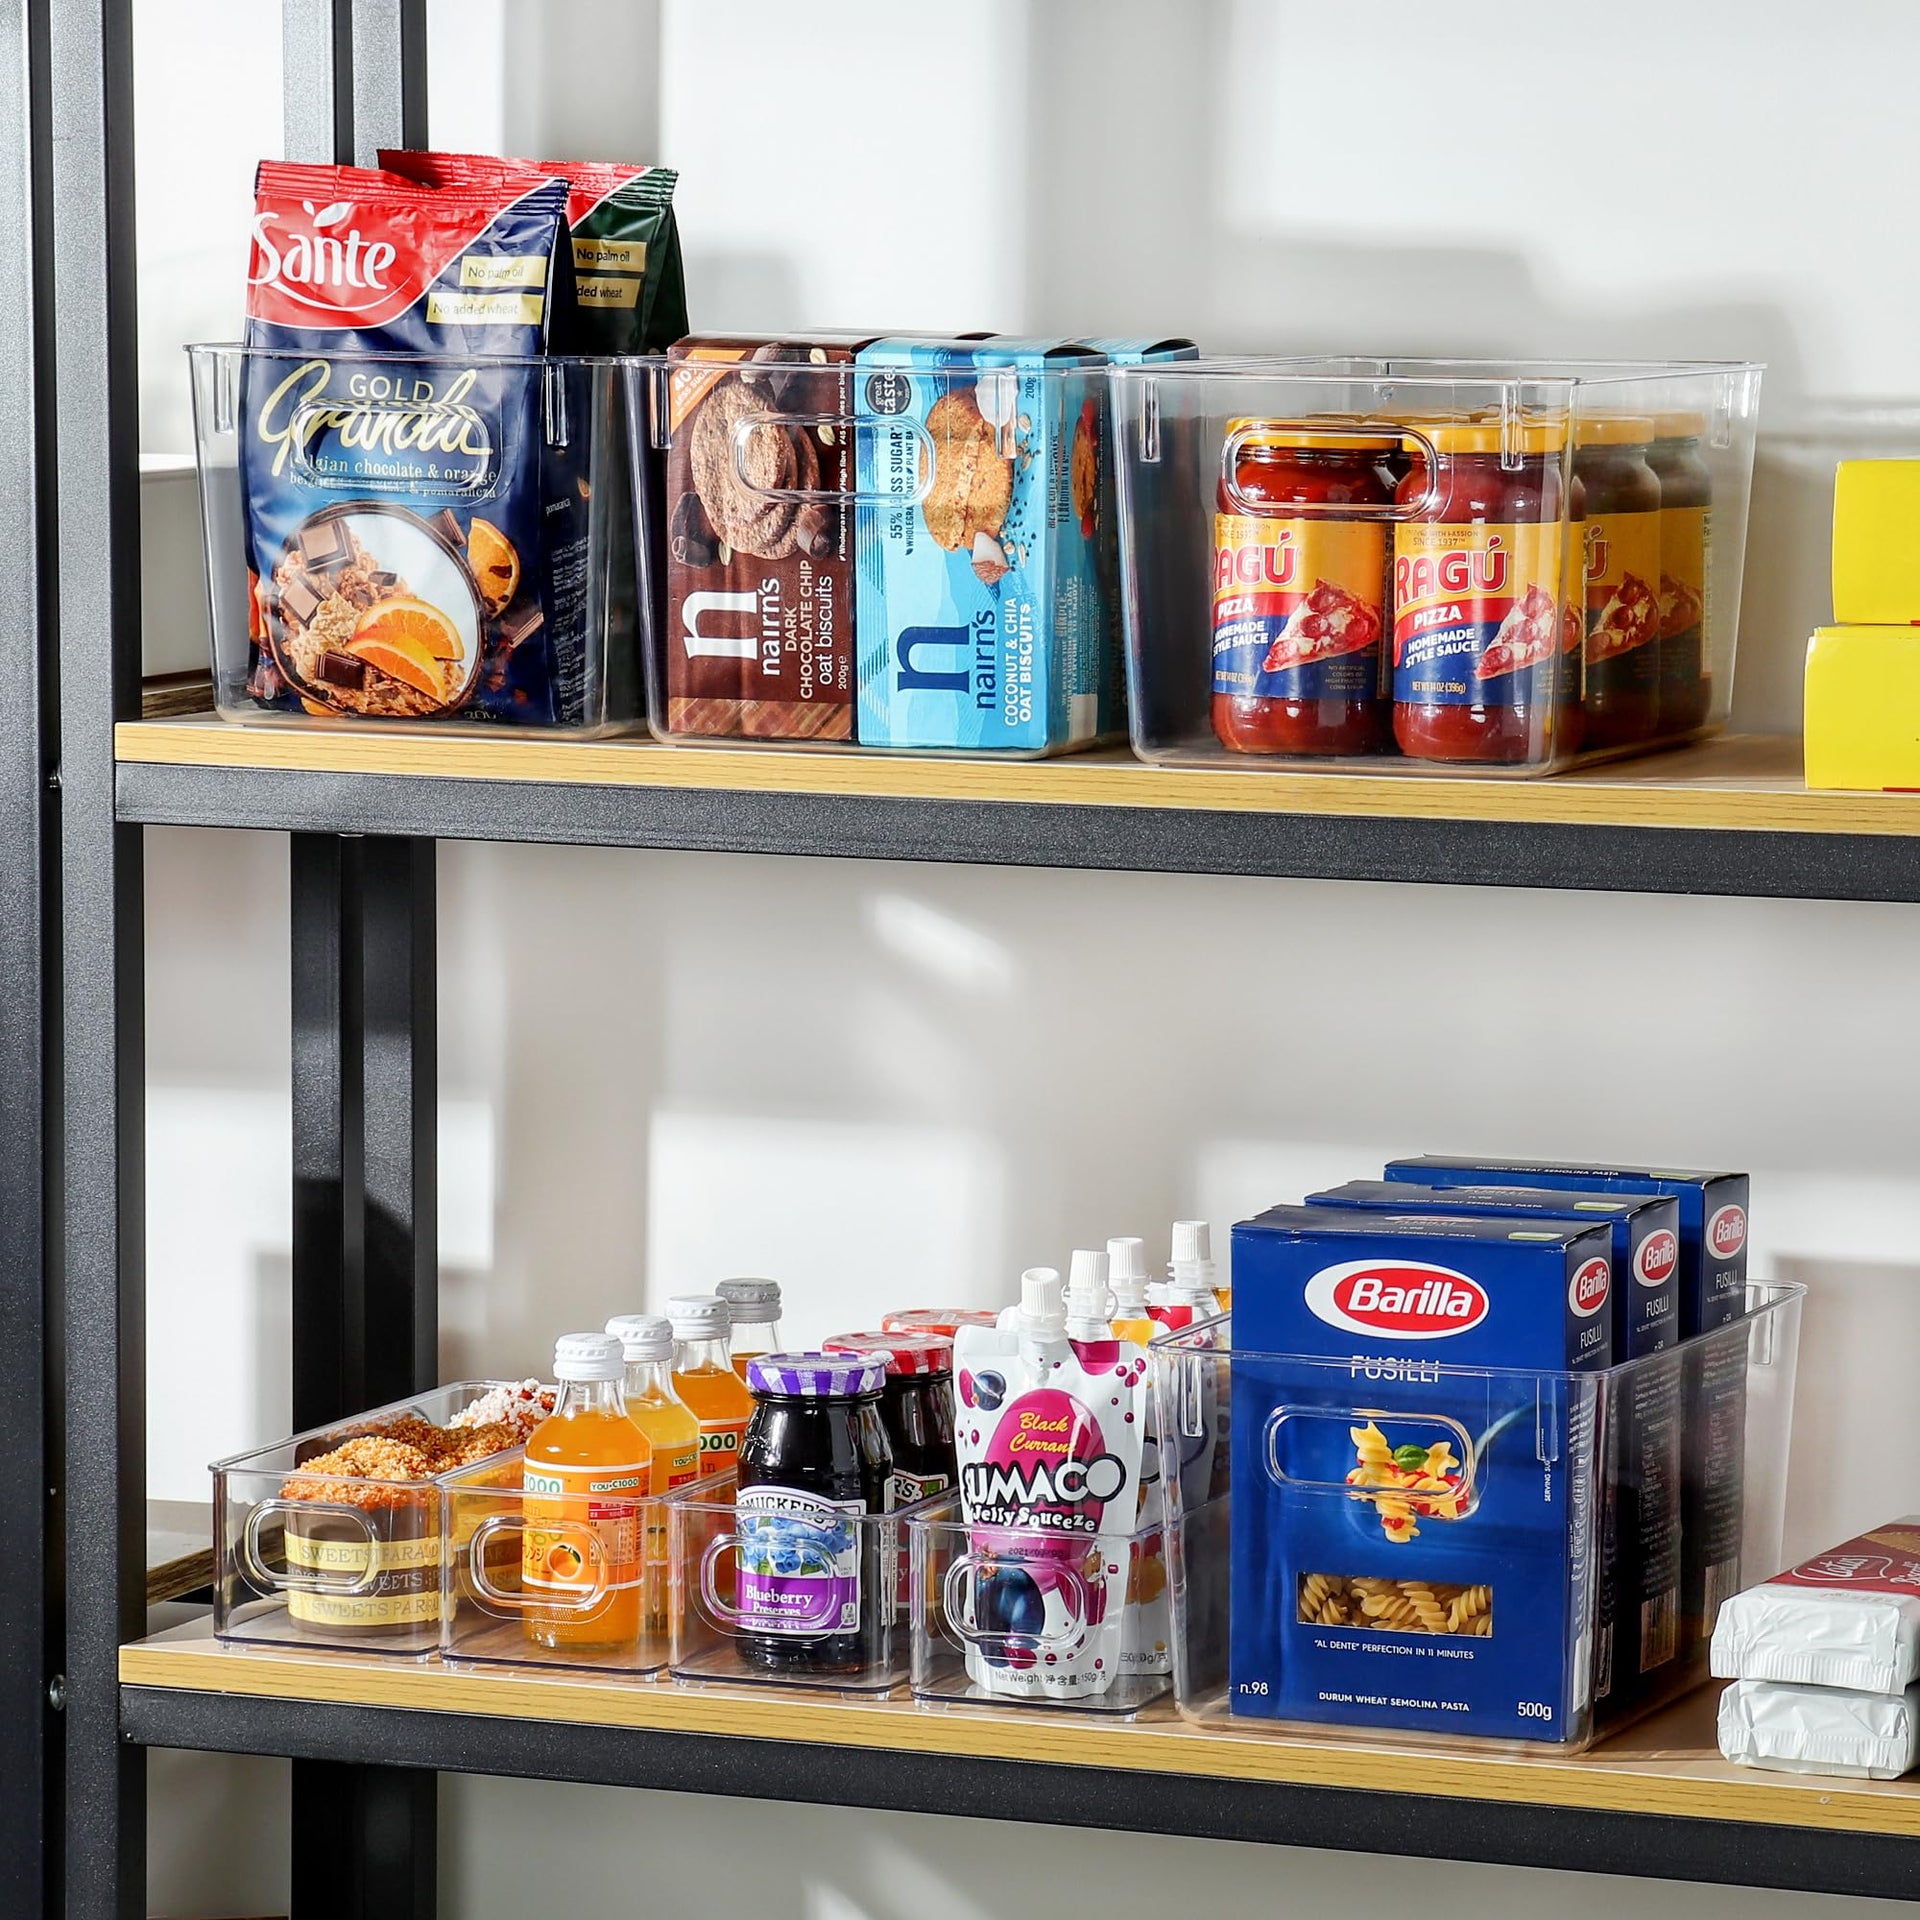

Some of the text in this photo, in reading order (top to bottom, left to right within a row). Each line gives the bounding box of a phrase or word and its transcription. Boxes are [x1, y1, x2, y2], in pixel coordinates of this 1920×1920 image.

[577, 249, 630, 262] No palm oil
[468, 265, 524, 280] No palm oil
[599, 286, 622, 298] wheat
[433, 302, 518, 315] No added wheat
[349, 374, 434, 405] GOLD
[905, 442, 914, 466] PLANT
[354, 458, 422, 478] chocolate
[889, 512, 903, 540] 55%
[905, 503, 914, 547] WHOLEGRA
[1215, 528, 1297, 592] AGÚ
[1396, 535, 1507, 606] RAGÚ
[1217, 598, 1254, 620] PIZZA
[1413, 604, 1463, 631] PIZZA
[784, 606, 798, 652] DARK
[799, 559, 813, 699] CHOCOLATE CHIP
[815, 575, 833, 685] oat biscuits
[1232, 632, 1268, 648] SAUCE
[1407, 627, 1476, 654] HOMEMADE
[1004, 597, 1019, 726] COCONUT & CHIA
[1018, 603, 1034, 722] OAT BISCUITS
[1404, 640, 1480, 669] STYLE SAUCE
[1716, 1215, 1744, 1244] Barilla
[1645, 1239, 1674, 1271] Barilla
[1579, 1267, 1607, 1301] Barilla
[1347, 1278, 1473, 1318] Barilla
[1646, 1294, 1669, 1318] FUSILLI
[1580, 1323, 1602, 1349] FUSILLI
[1351, 1355, 1440, 1383] FUSILLI
[1018, 1411, 1070, 1432] Black
[1543, 1473, 1552, 1502] SERVING
[973, 1505, 1096, 1532] Jelly Squeeze
[349, 1571, 423, 1592] WEETS
[312, 1601, 389, 1618] SWEETS
[746, 1584, 814, 1610] Blueberry
[753, 1601, 802, 1616] Preserves
[1362, 1643, 1413, 1655] PERFECTION
[1416, 1648, 1425, 1656] IN
[1428, 1648, 1434, 1657] 11
[1436, 1649, 1474, 1660] MINUTES
[1240, 1681, 1269, 1696] n.98
[1319, 1692, 1470, 1712] DURUM WHEAT SEMOLINA PASTA
[1517, 1701, 1552, 1721] 500g
